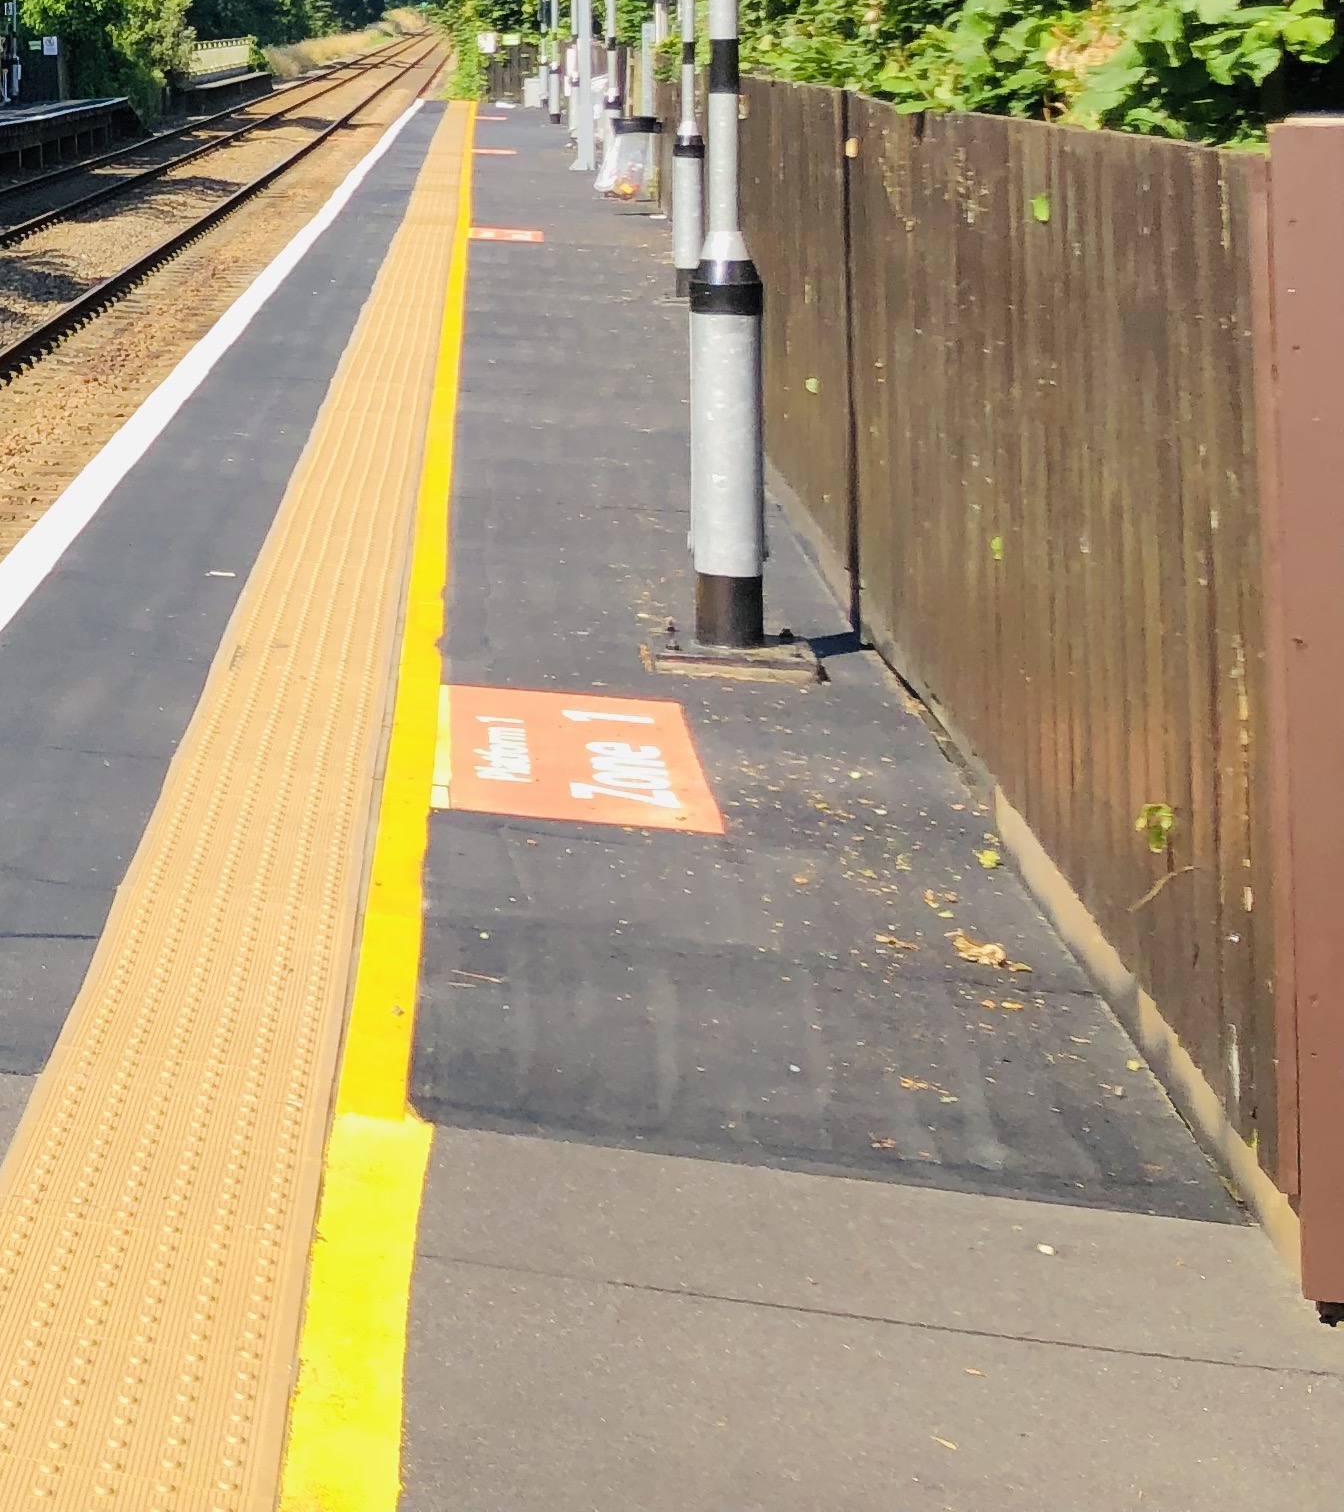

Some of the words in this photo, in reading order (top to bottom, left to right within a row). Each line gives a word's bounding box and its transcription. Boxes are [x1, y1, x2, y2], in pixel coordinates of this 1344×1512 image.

[475, 715, 525, 724] 1
[561, 709, 656, 725] 1
[473, 725, 532, 783] Platform
[569, 740, 681, 809] Zone
